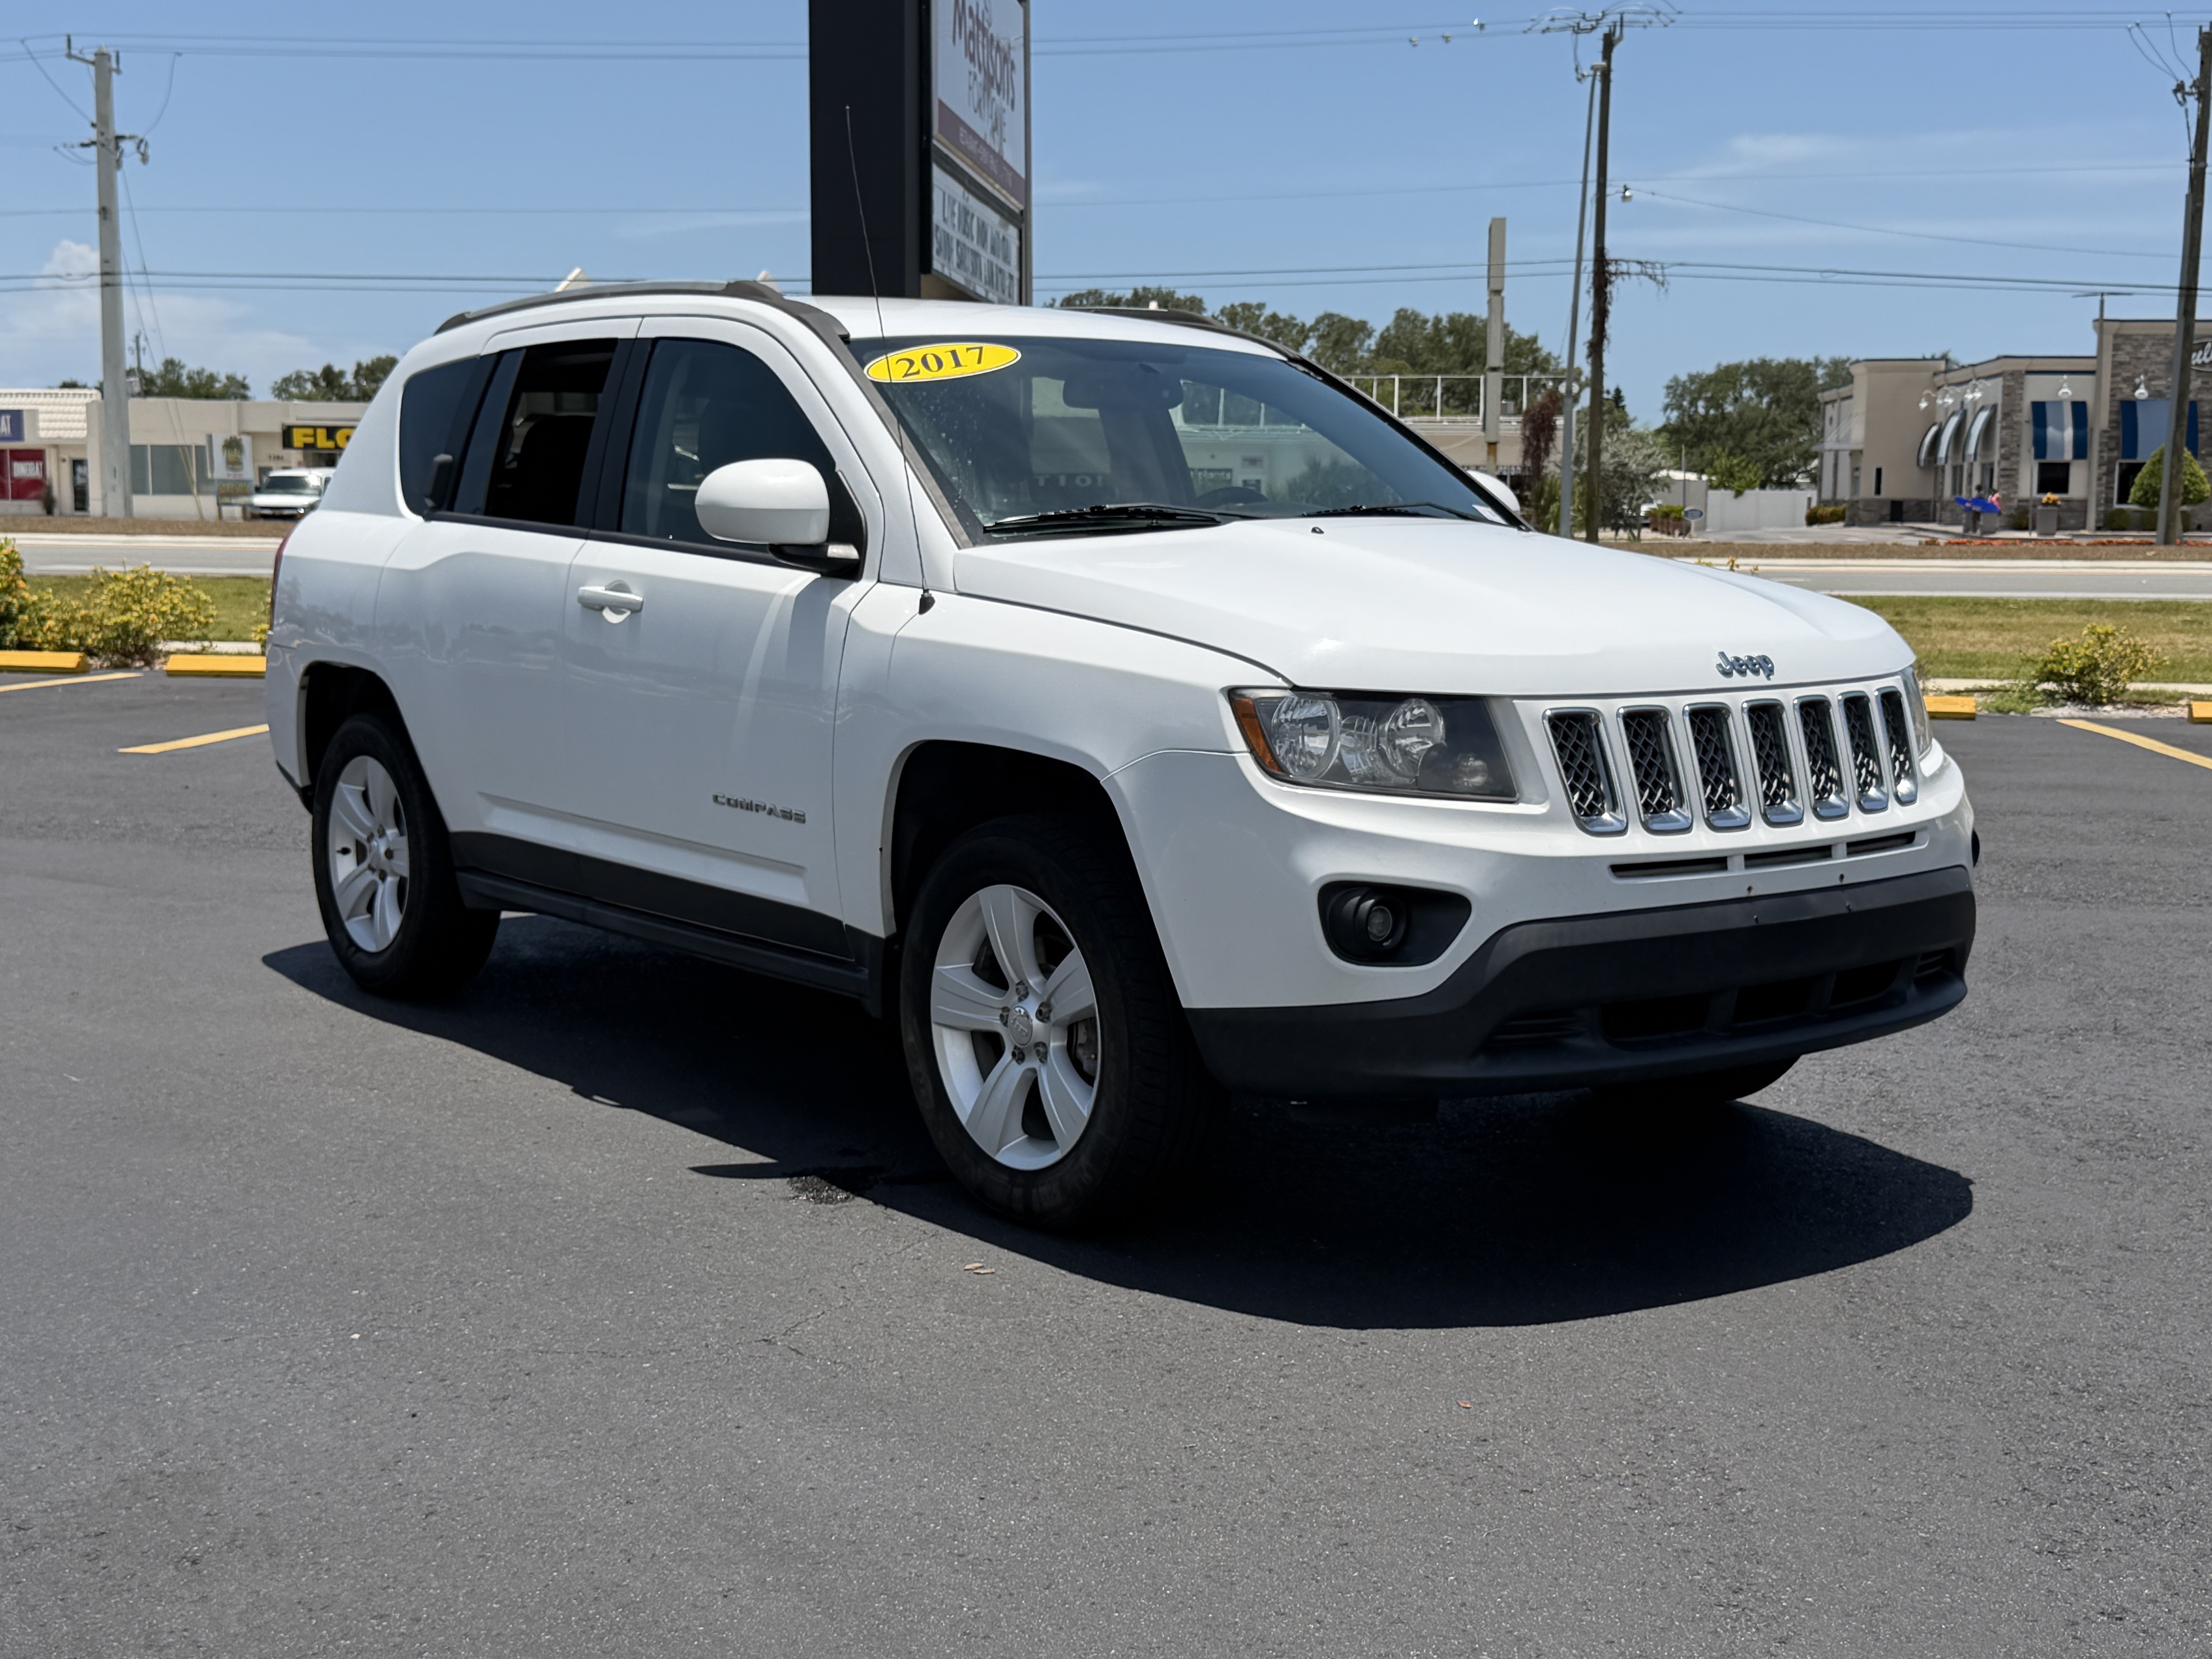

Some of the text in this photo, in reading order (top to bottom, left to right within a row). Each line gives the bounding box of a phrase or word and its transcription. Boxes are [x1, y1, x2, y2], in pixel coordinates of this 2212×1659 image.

[895, 346, 984, 378] 2017
[1716, 651, 1774, 681] Jeep
[713, 792, 806, 824] COMPASS
